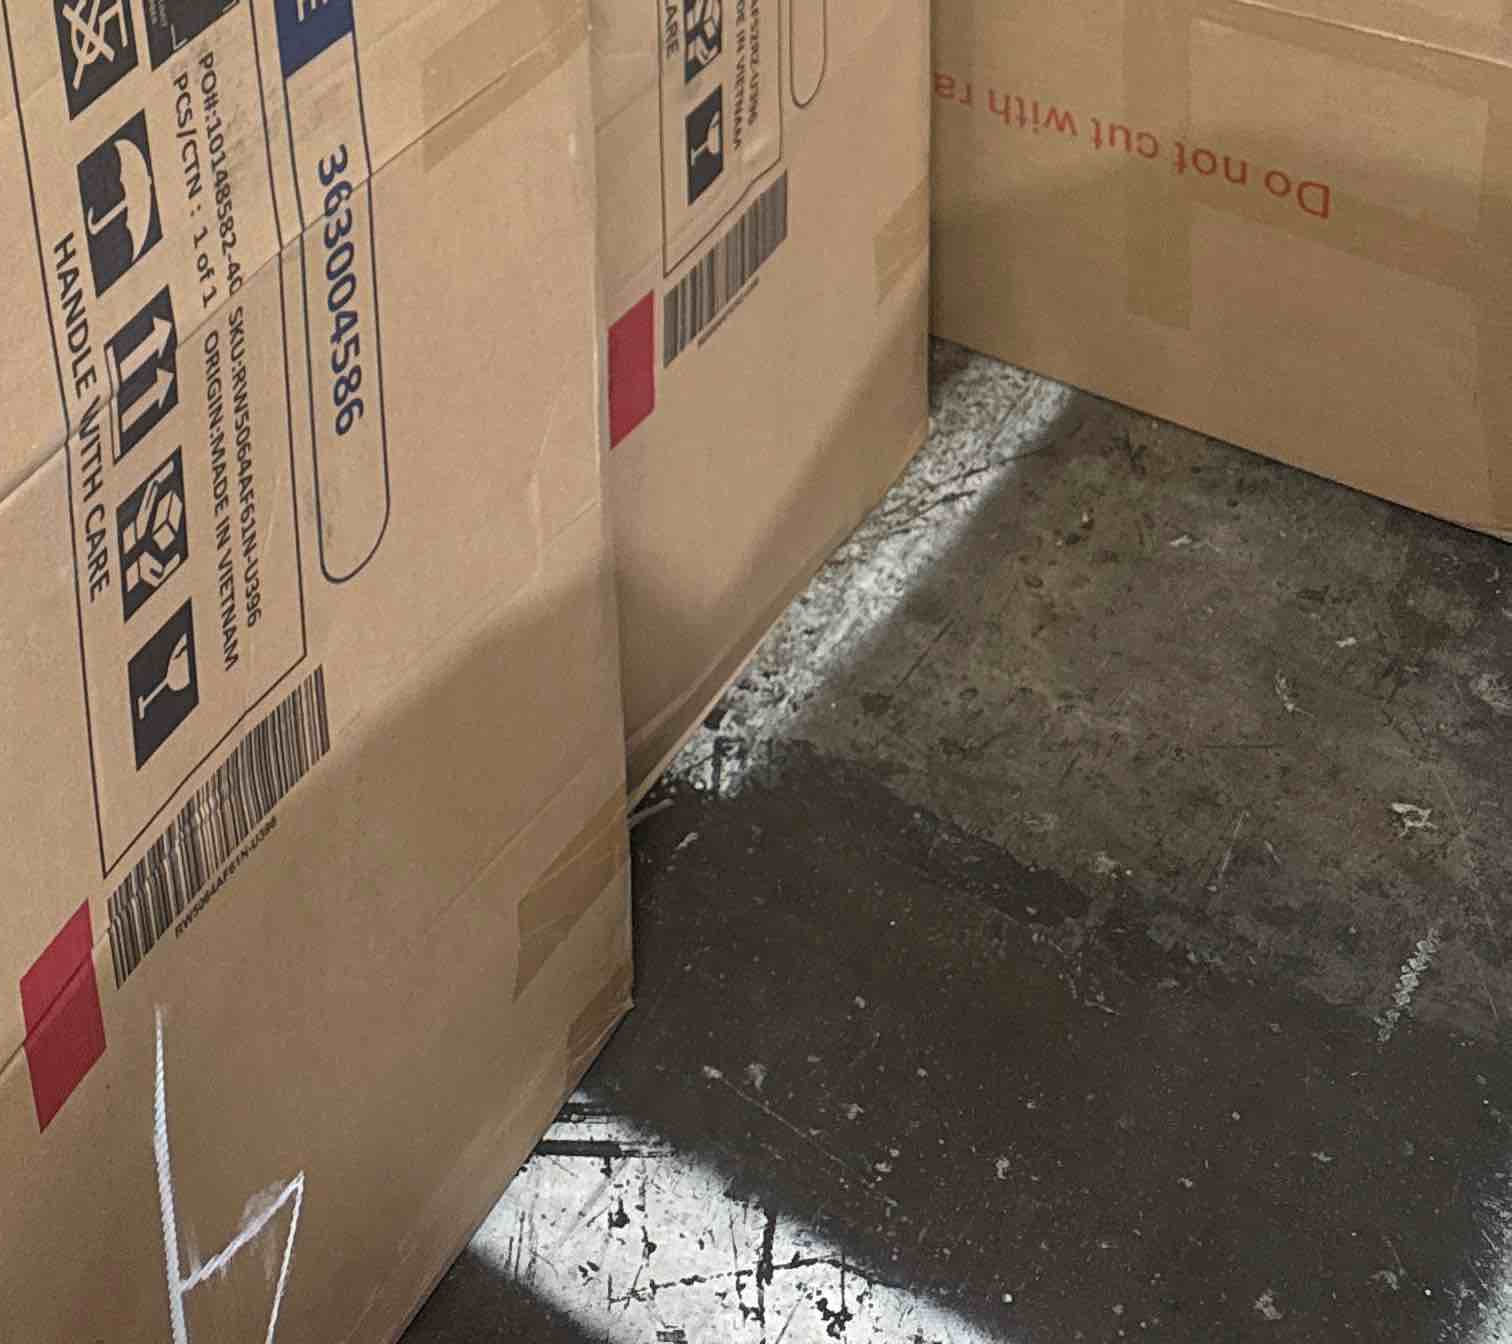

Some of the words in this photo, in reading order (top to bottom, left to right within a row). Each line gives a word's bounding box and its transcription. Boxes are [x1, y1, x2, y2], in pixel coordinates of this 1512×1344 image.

[173, 73, 204, 201] PCS/CTN
[988, 88, 1079, 137] with
[1091, 117, 1159, 161] cut
[1175, 139, 1248, 187] not
[1265, 167, 1332, 221] Do
[53, 230, 98, 400] HANDLE
[318, 144, 366, 437] 363004586
[78, 396, 106, 501] WITH
[204, 329, 231, 516] ORIGIN:MADE
[84, 502, 111, 603] CARE
[216, 515, 235, 553] IN
[219, 550, 240, 673] VIETNAM
